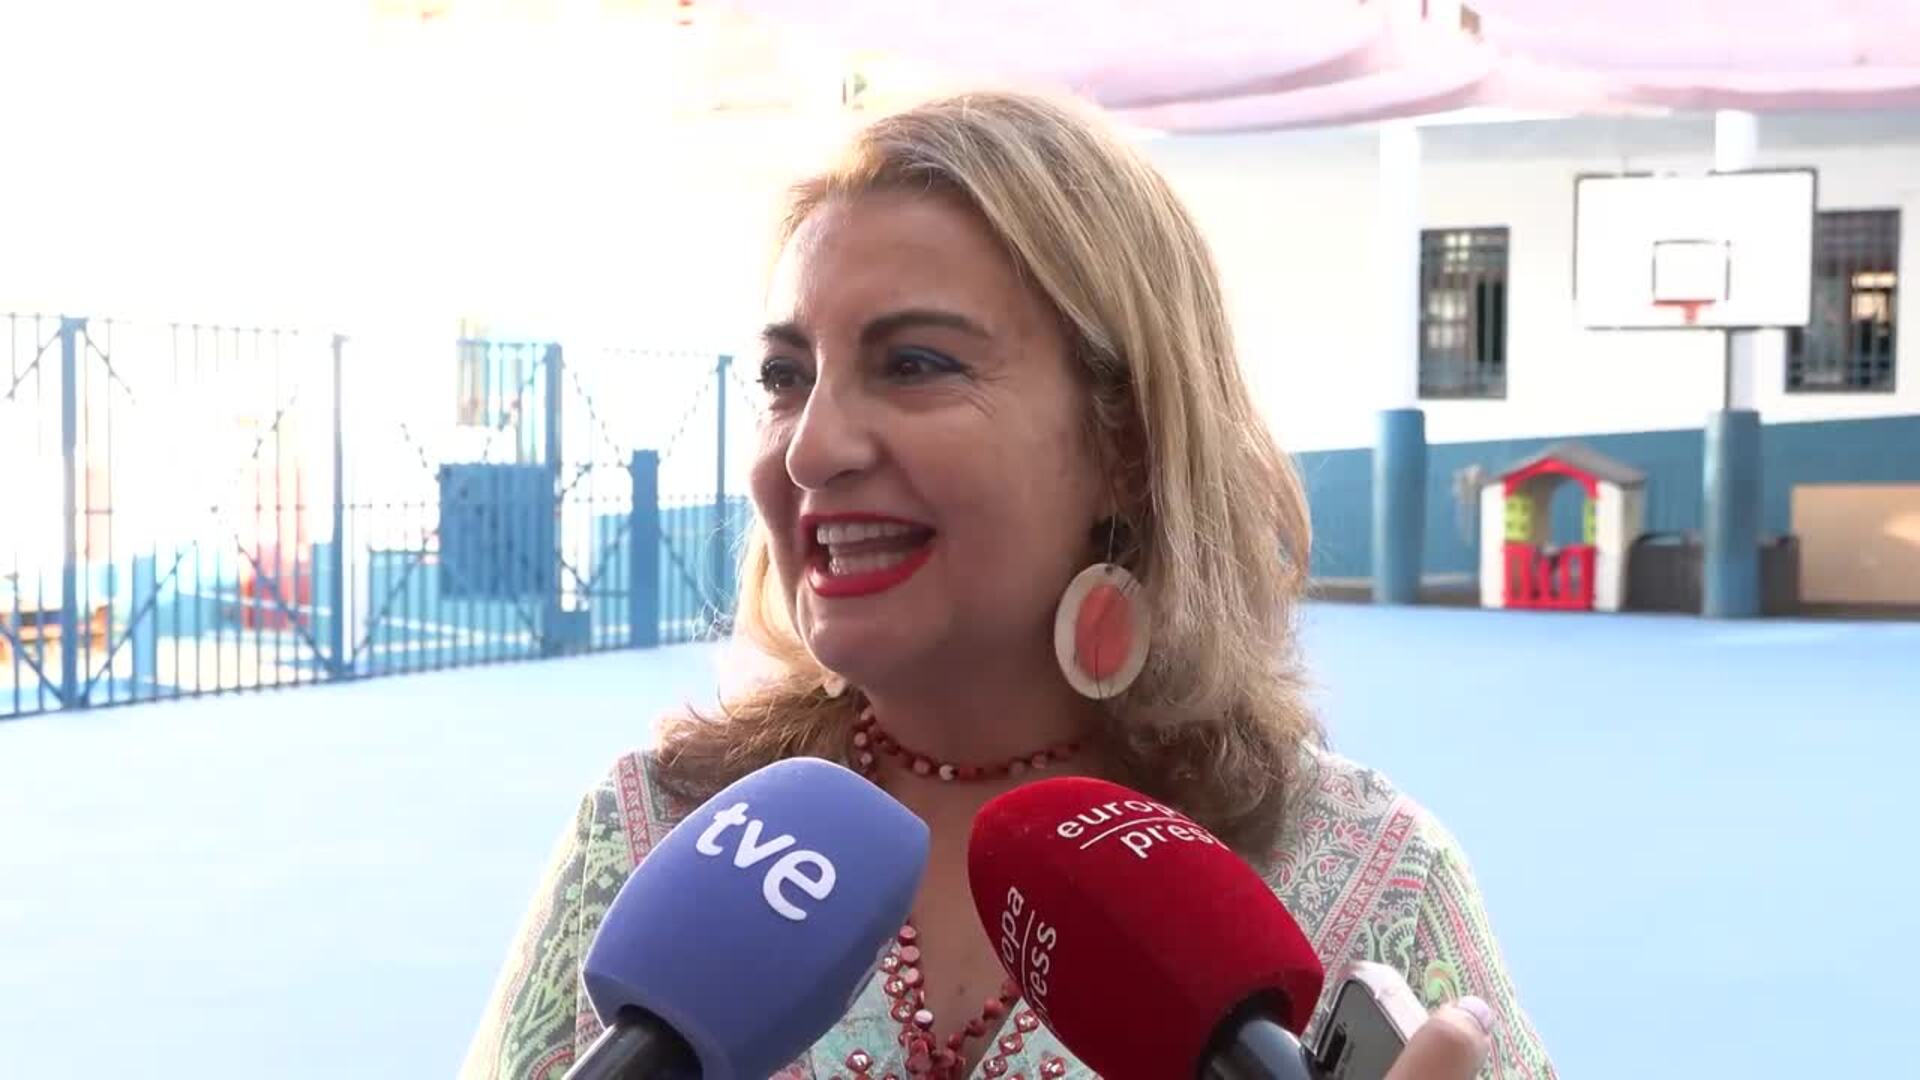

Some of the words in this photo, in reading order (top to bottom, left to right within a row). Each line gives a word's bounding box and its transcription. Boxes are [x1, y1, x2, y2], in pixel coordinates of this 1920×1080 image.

[1057, 800, 1191, 838] europ
[1120, 825, 1229, 858] pres
[696, 802, 836, 921] tve
[1030, 922, 1060, 1036] ress
